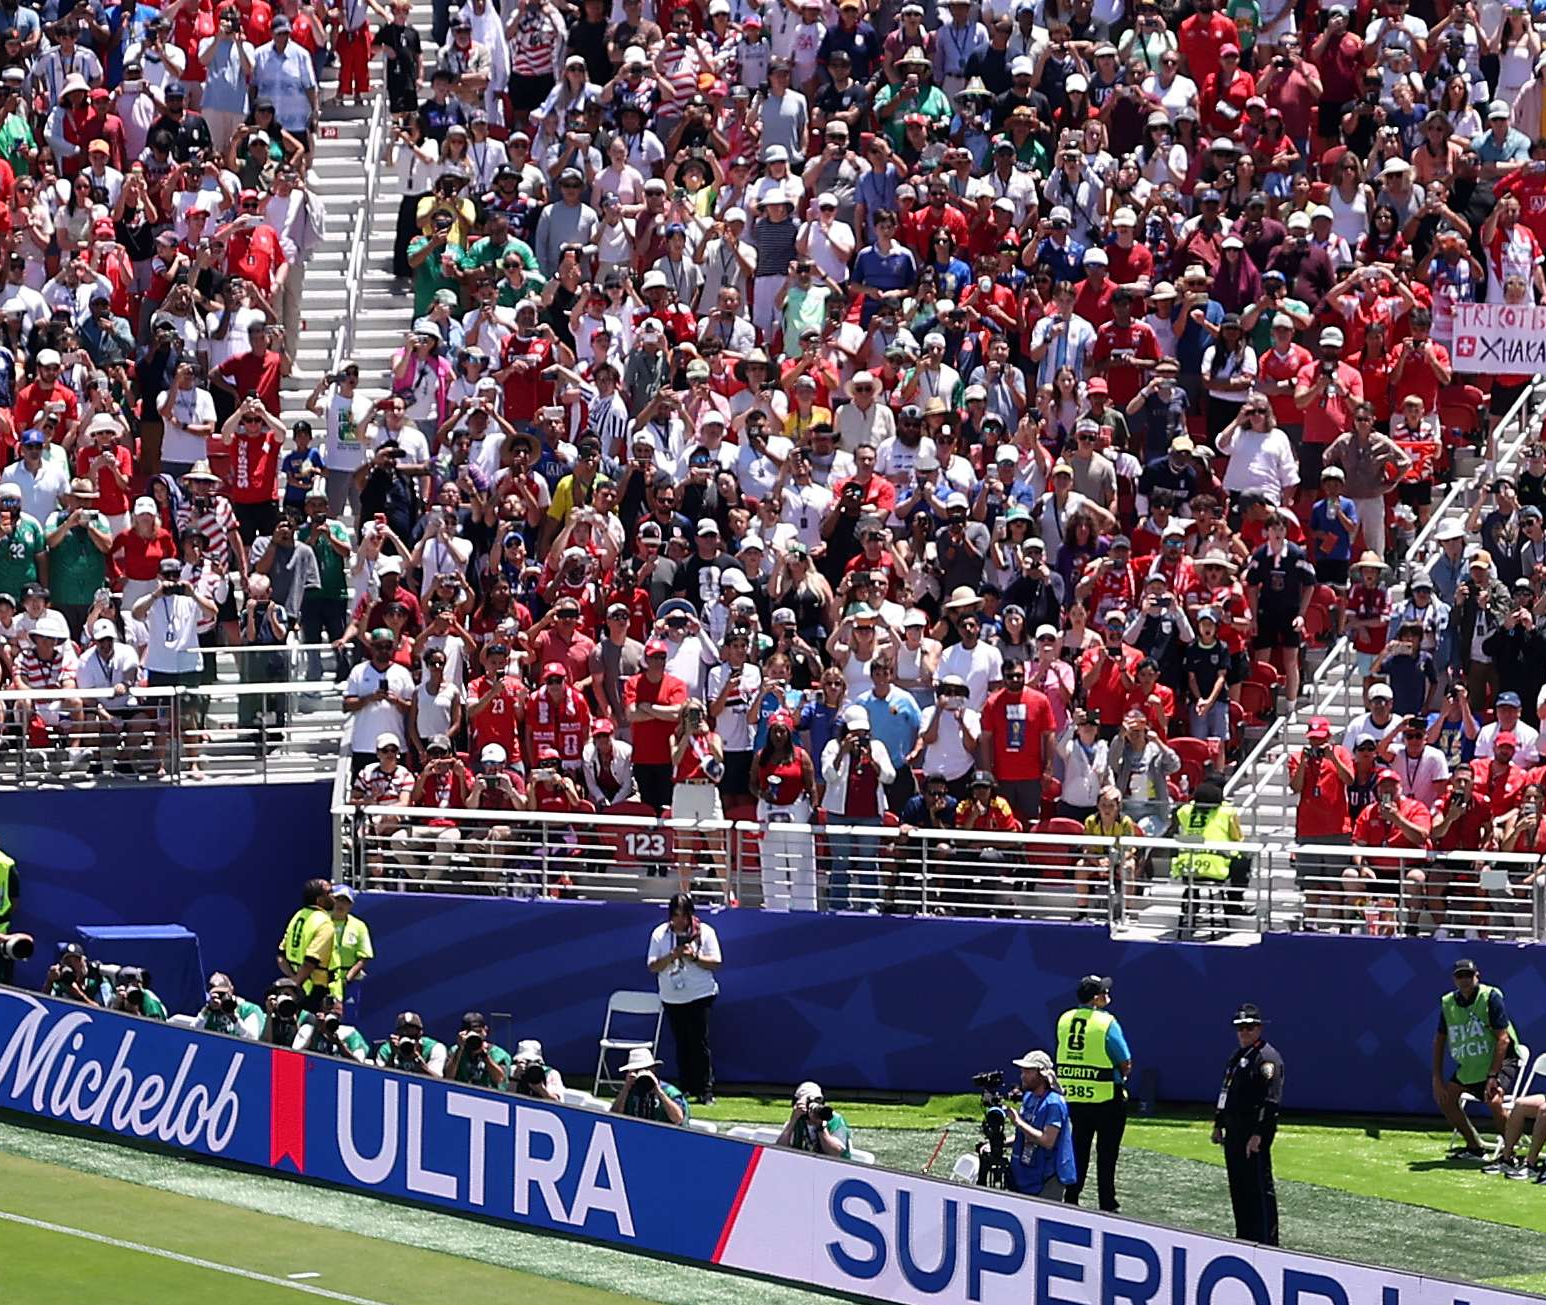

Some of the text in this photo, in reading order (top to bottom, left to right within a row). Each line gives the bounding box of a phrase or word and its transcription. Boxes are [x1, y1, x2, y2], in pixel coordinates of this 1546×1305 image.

[1457, 303, 1529, 329] TRICOT
[1479, 335, 1546, 364] XHAKA
[237, 440, 250, 489] SUISSE
[491, 698, 504, 714] 23
[624, 832, 666, 857] 123
[1057, 1065, 1100, 1079] ECURITY
[335, 1067, 637, 1239] ULTRA
